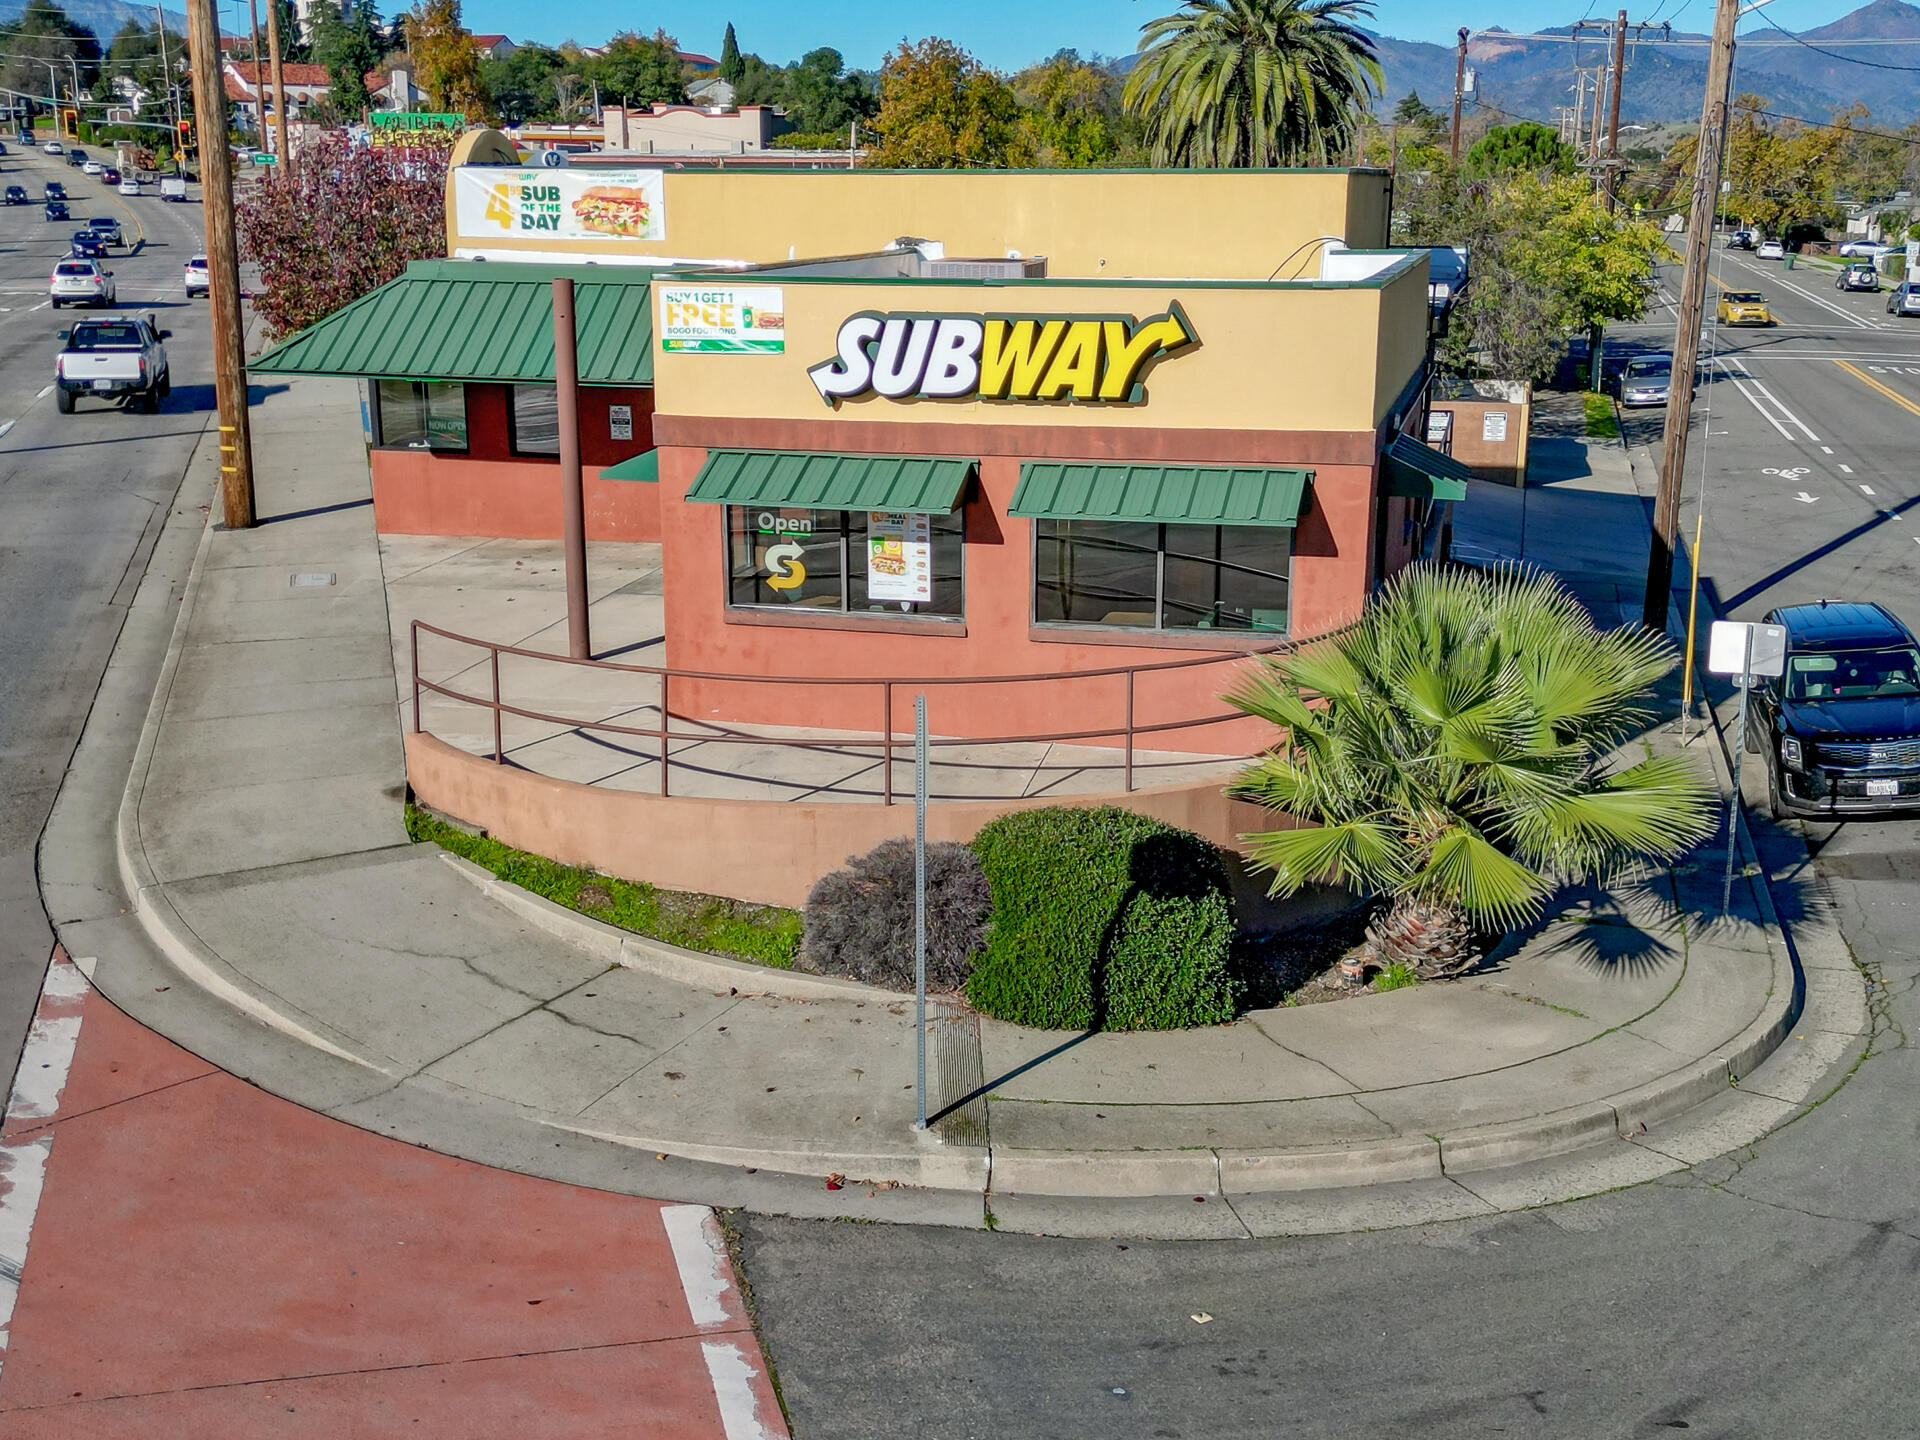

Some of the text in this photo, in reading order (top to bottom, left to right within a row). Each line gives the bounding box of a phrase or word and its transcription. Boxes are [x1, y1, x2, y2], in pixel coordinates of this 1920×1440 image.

[520, 186, 560, 201] SUB
[521, 204, 561, 212] OF THE
[520, 214, 561, 230] DAY
[666, 292, 691, 303] BUY
[702, 293, 724, 303] GET
[728, 293, 733, 303] 1
[667, 303, 736, 327] FREE
[808, 307, 1192, 402] SUBWAY
[758, 511, 812, 535] Open
